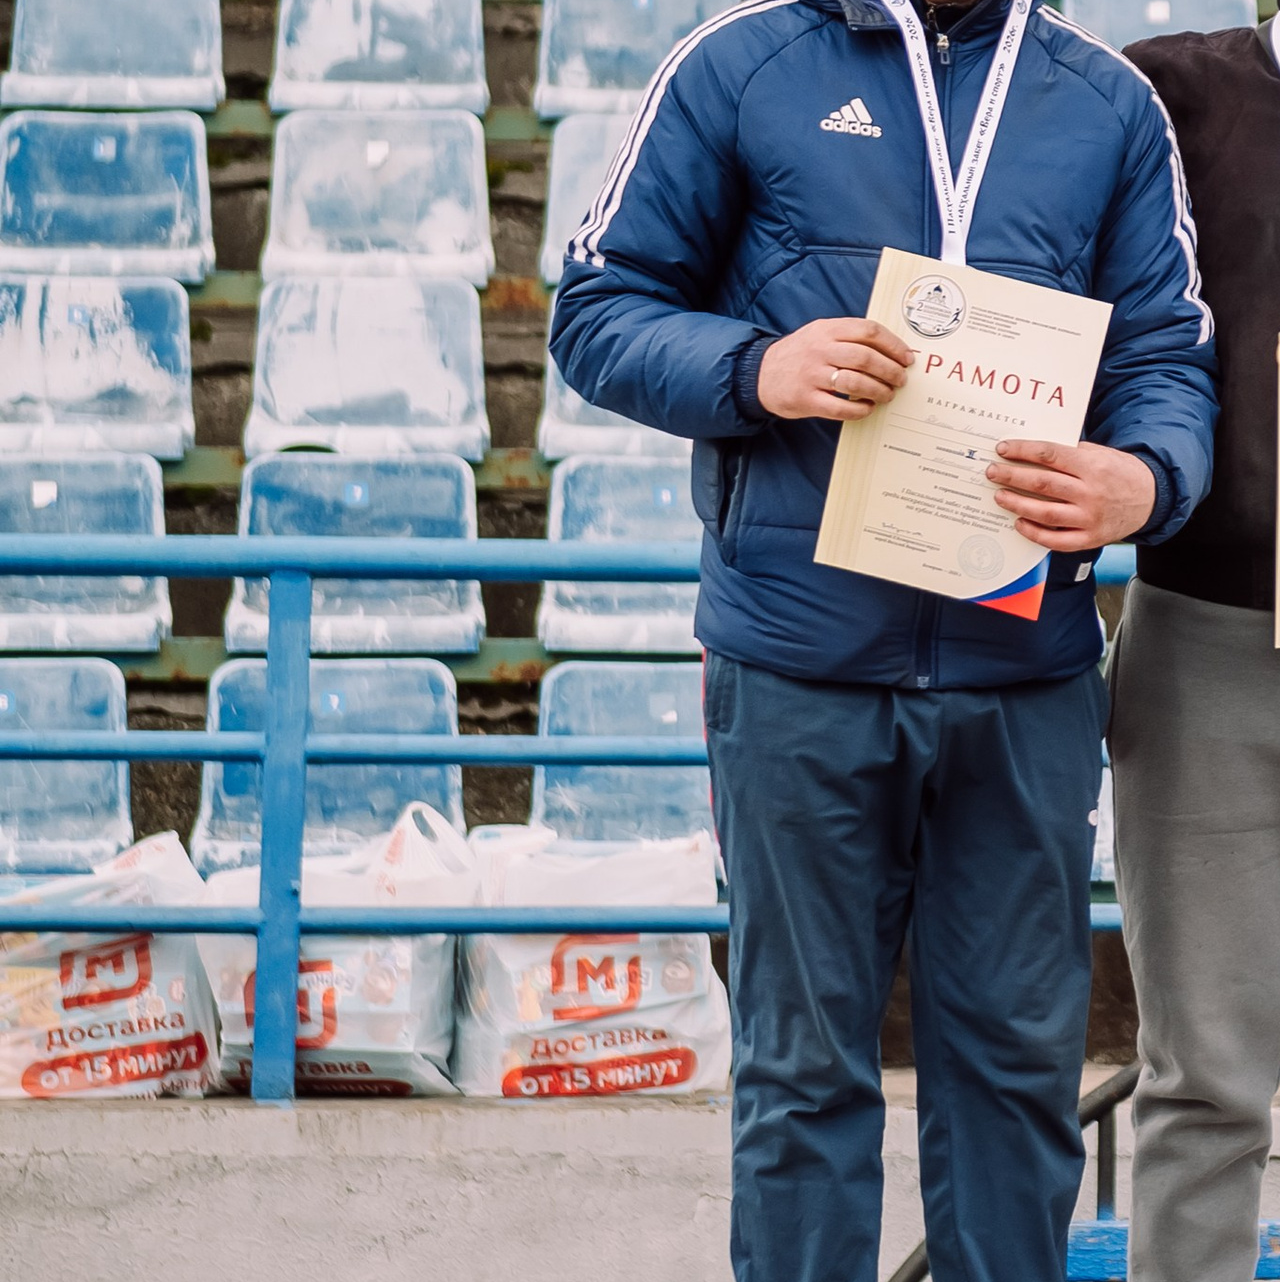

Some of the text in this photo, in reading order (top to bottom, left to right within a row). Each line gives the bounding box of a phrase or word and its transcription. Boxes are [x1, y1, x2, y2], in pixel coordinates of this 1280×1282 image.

[819, 119, 883, 139] adidas
[927, 396, 1027, 427] НАГРАЖДАЕТСЯ
[46, 1013, 185, 1051] Доставка
[531, 1029, 668, 1059] Доставка
[40, 1044, 199, 1089] от 15 минут
[519, 1058, 682, 1095] от 15 минут
